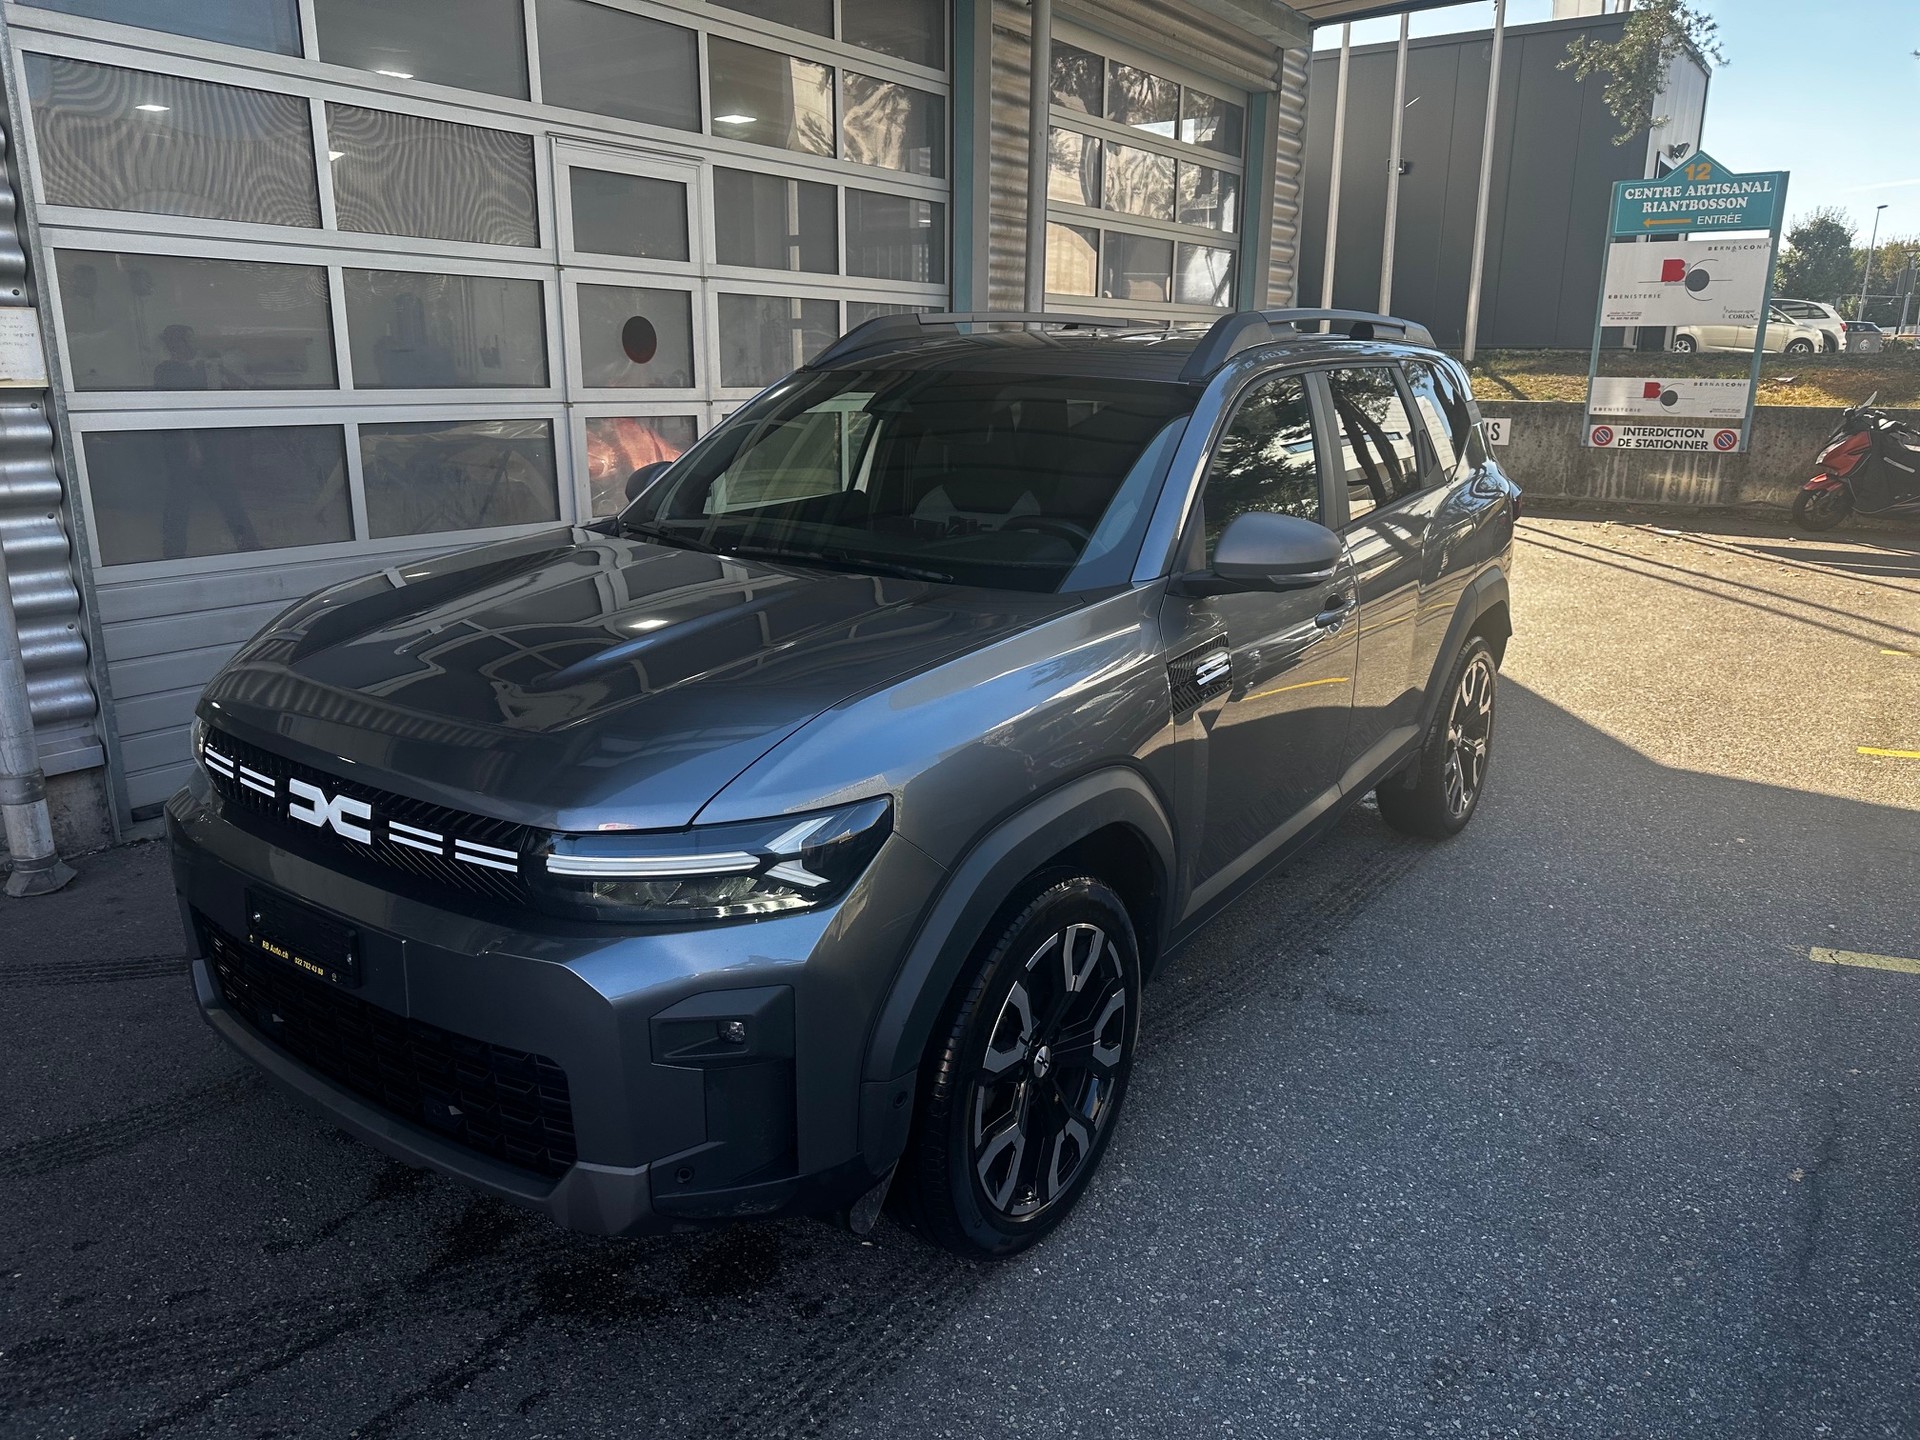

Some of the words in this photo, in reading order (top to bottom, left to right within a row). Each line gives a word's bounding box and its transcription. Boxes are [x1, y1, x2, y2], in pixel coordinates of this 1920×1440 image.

[1684, 163, 1712, 181] 12
[1624, 185, 1682, 200] CENTRE
[1685, 181, 1772, 196] ARTISANAL
[1642, 197, 1748, 213] RIANTBOSSON
[1697, 212, 1742, 225] ENTRÉE
[1623, 427, 1705, 438] INTERDICTION
[1617, 438, 1631, 447] DE
[1635, 439, 1708, 450] STATIONNER
